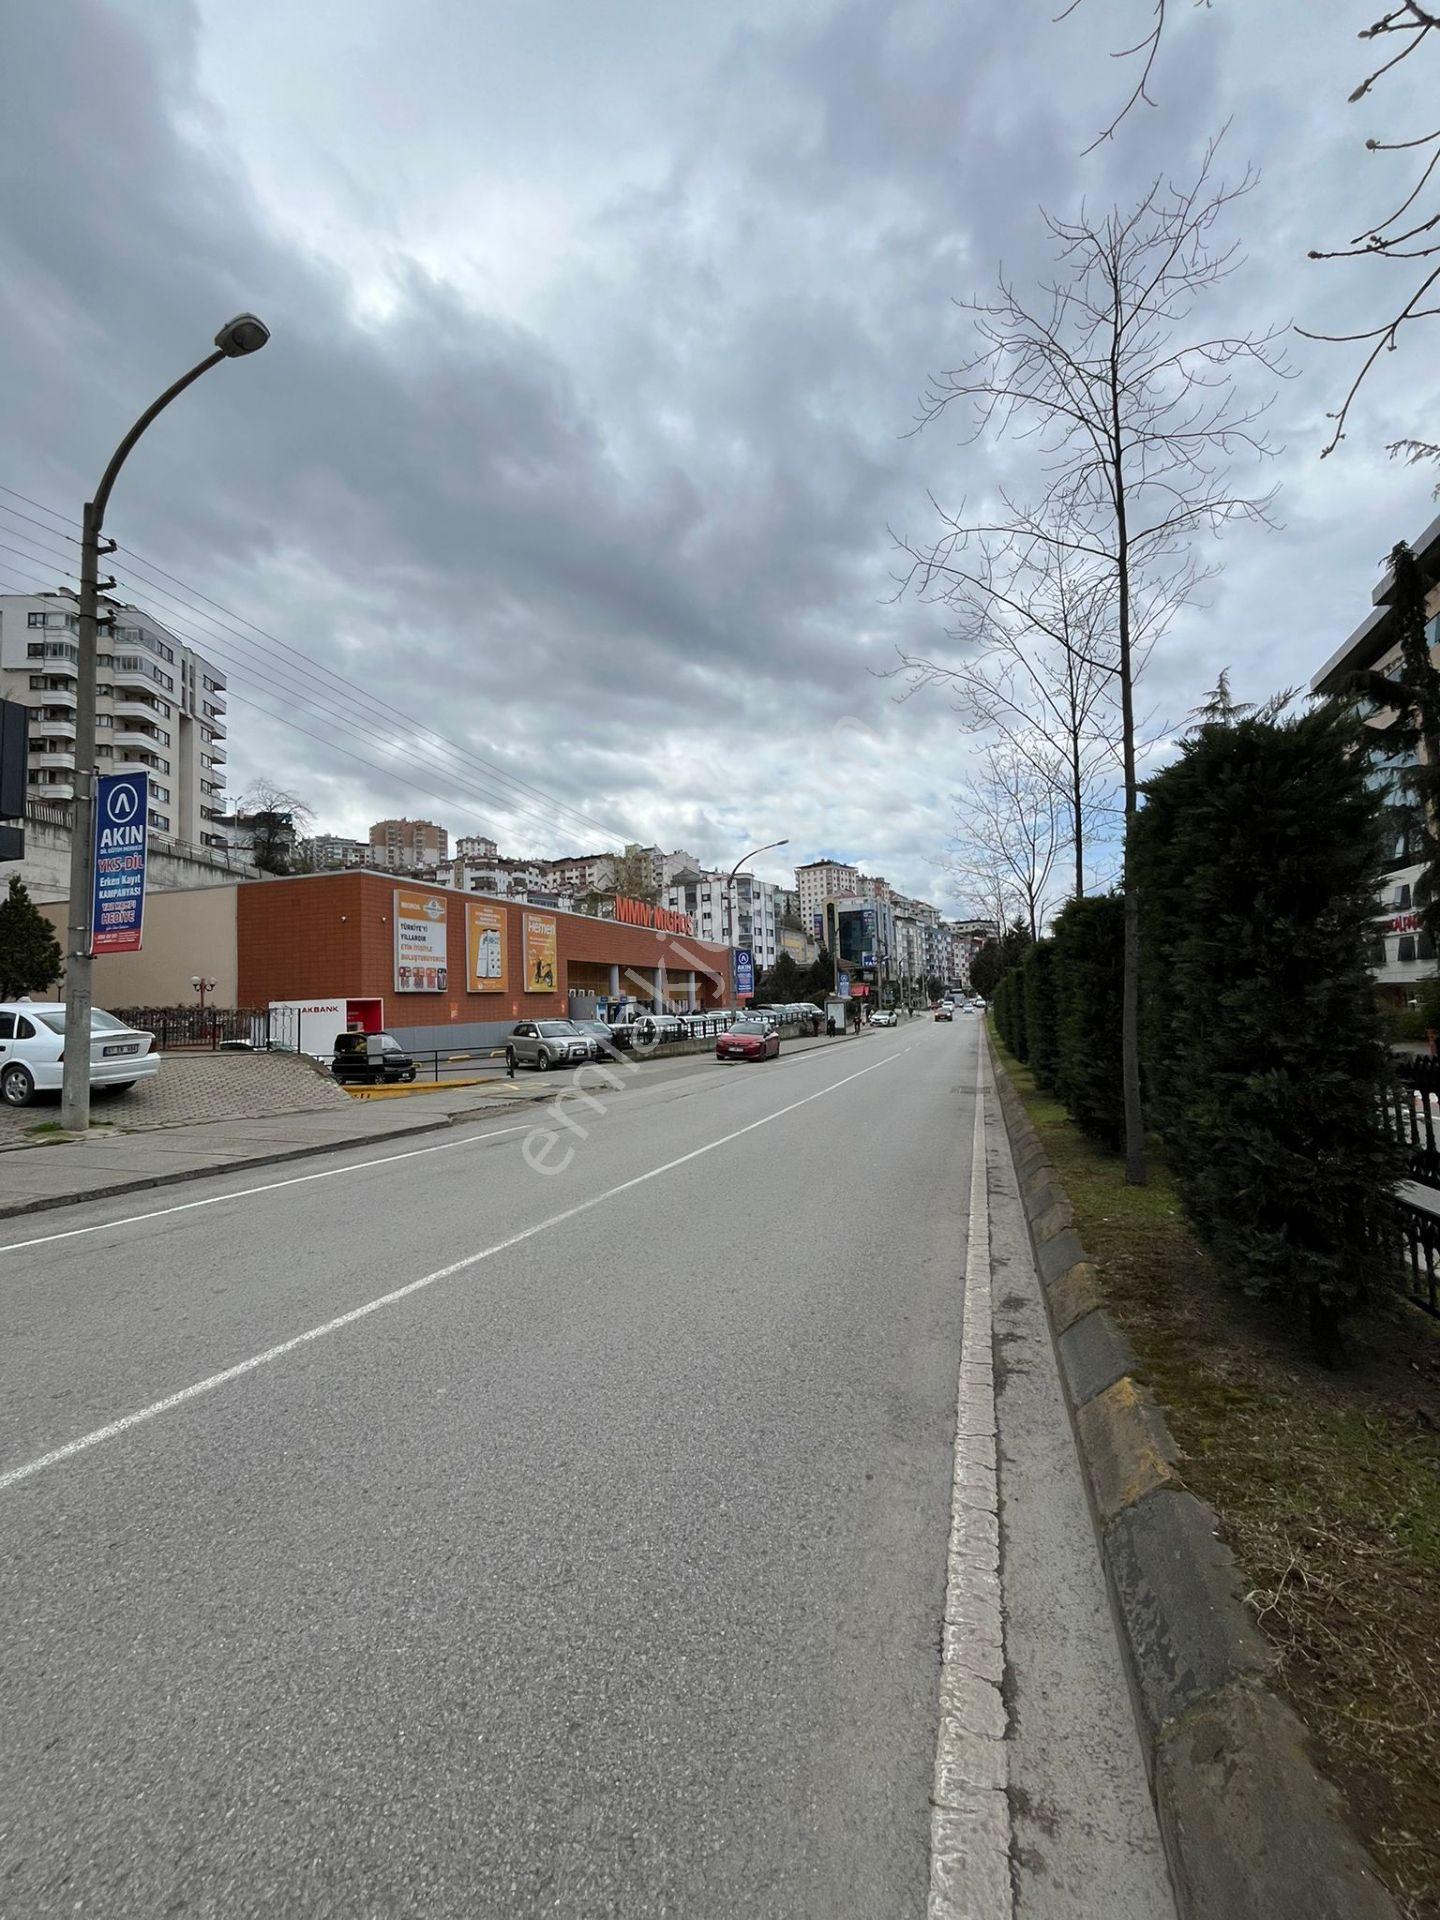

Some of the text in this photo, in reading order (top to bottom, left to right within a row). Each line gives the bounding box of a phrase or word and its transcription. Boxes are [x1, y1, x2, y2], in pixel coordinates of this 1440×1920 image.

[101, 825, 143, 847] AKIN
[98, 853, 144, 873] YKS-DİL
[100, 874, 141, 887] Erken Kayıt
[99, 886, 141, 899] KAMPANYASI
[101, 910, 135, 924] HEDİYE
[302, 1006, 339, 1014] AKBANK
